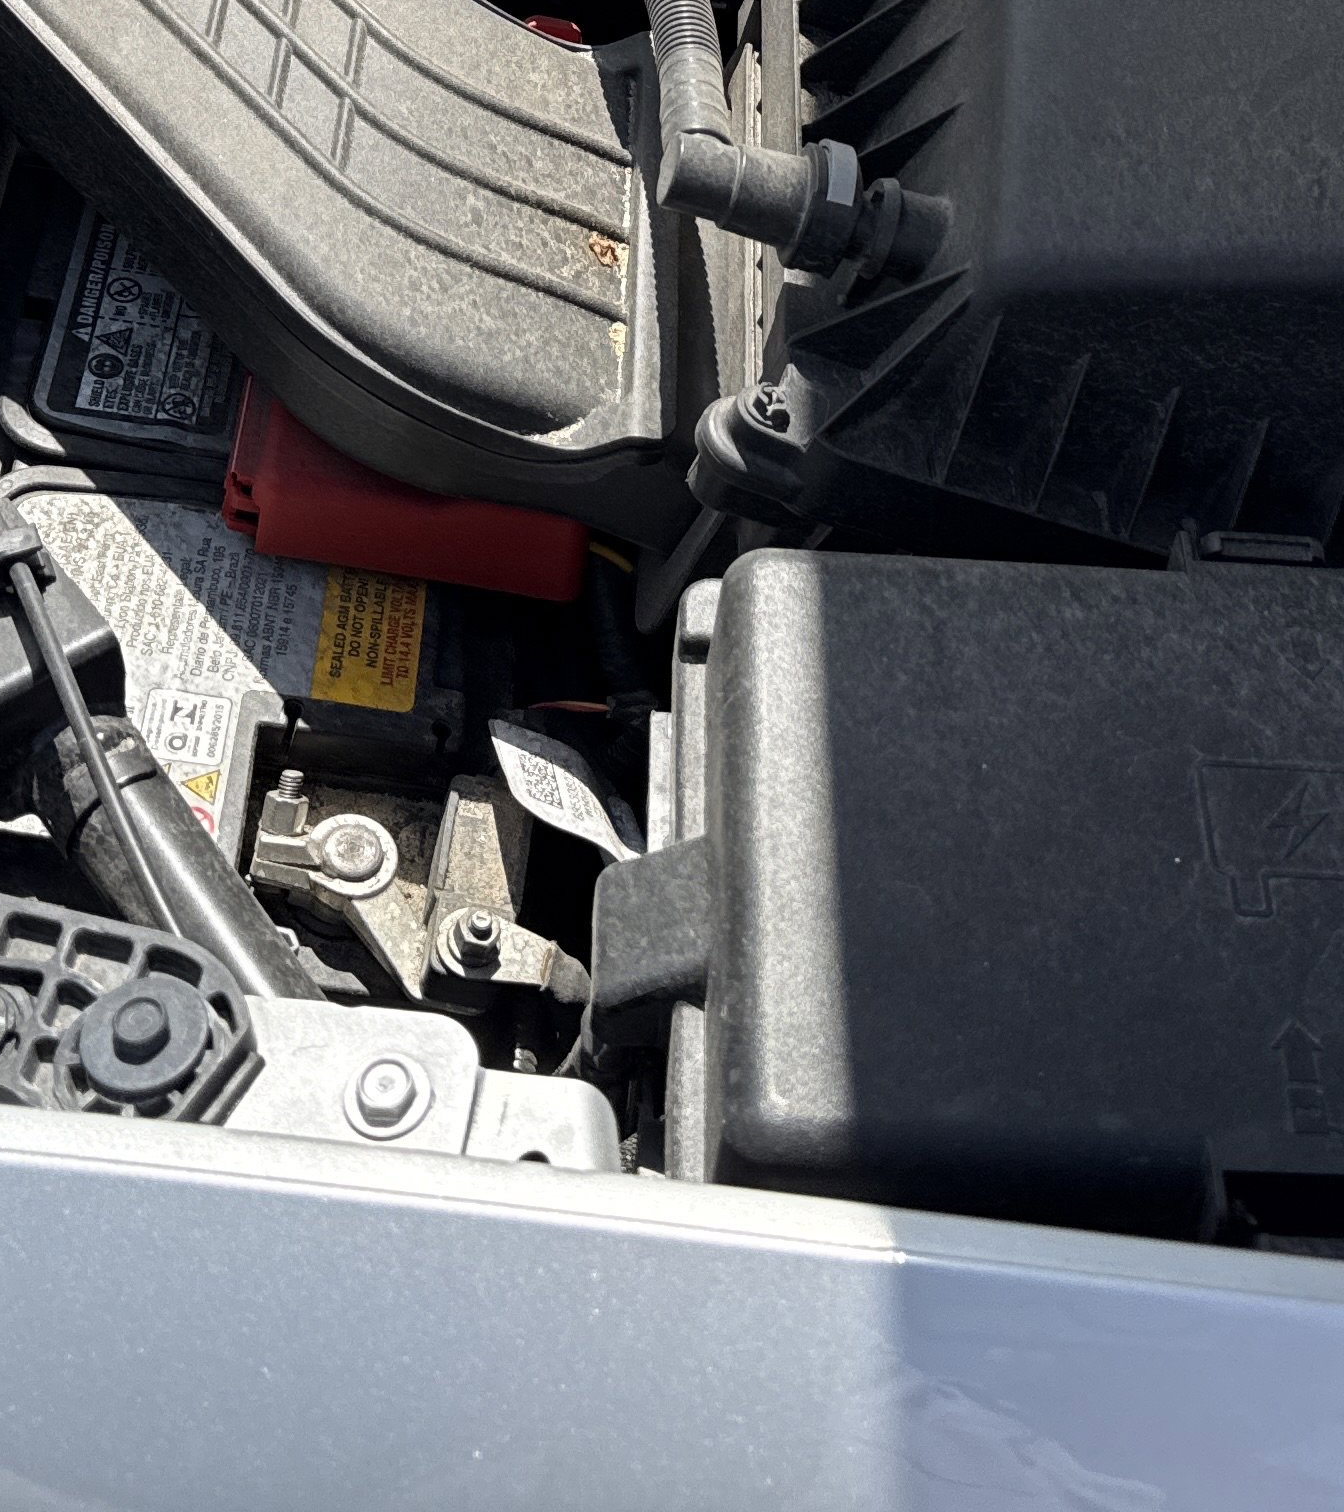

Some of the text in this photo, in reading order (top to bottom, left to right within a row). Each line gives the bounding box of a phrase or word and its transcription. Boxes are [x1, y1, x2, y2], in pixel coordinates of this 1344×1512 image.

[194, 559, 207, 574] SA
[261, 613, 276, 643] ABNT
[336, 605, 350, 630] AGM
[350, 613, 365, 638] NOT
[365, 577, 389, 669] NON-SPILLABLE
[400, 608, 417, 640] VOLTS
[347, 640, 361, 658] DO
[383, 615, 402, 655] CHARGE
[328, 632, 347, 679] SEALED
[380, 656, 396, 687] LIMIT
